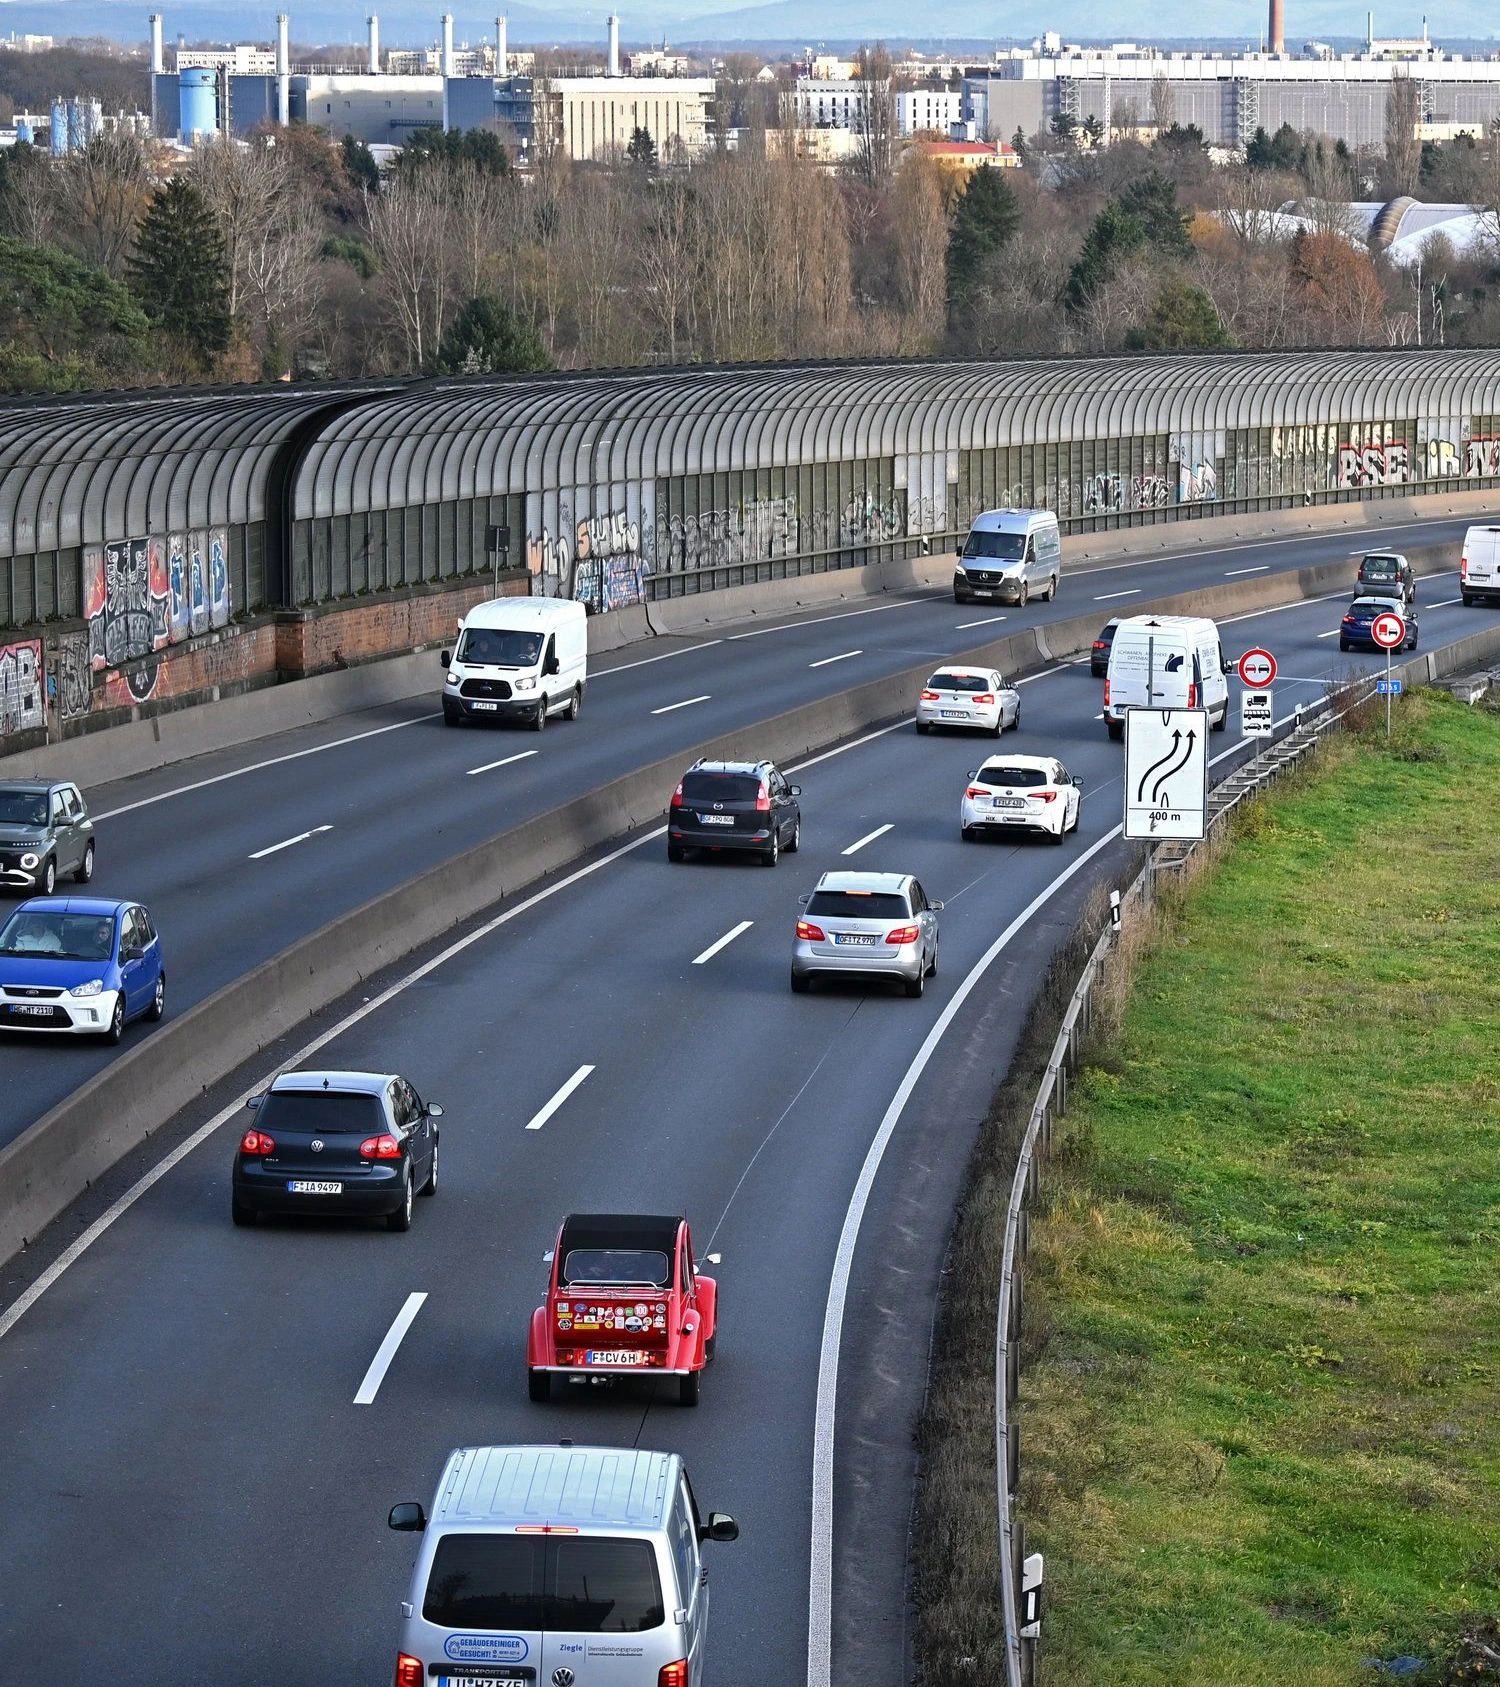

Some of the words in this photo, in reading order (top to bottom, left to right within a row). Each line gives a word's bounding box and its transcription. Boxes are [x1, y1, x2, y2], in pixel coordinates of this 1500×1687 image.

[1149, 811, 1167, 821] 400
[317, 1183, 340, 1192] 9497
[460, 1638, 520, 1648] GEBÄUDEREINIGER
[460, 1650, 491, 1658] GESUCHT!
[453, 1667, 510, 1675] TRANSPORTER
